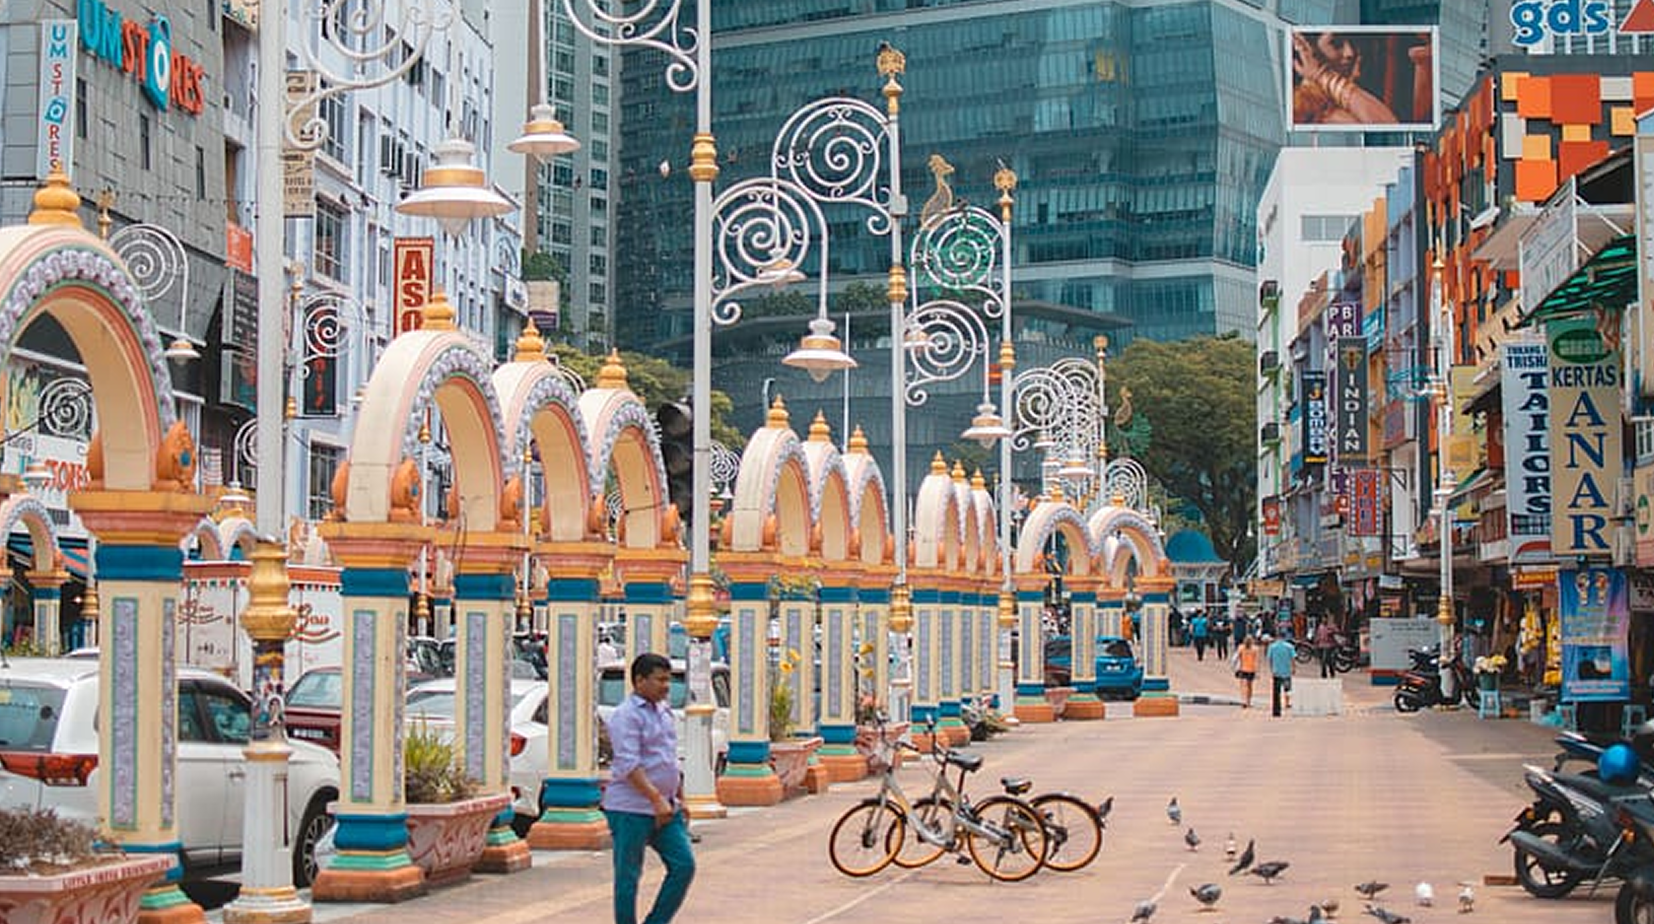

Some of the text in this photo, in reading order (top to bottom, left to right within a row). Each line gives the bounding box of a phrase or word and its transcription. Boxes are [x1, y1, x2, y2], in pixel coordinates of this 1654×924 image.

[1511, 0, 1610, 45] gds
[1551, 365, 1617, 388] KERTAS
[1344, 373, 1360, 451] INDIAN
[1564, 391, 1611, 550] ANAR
